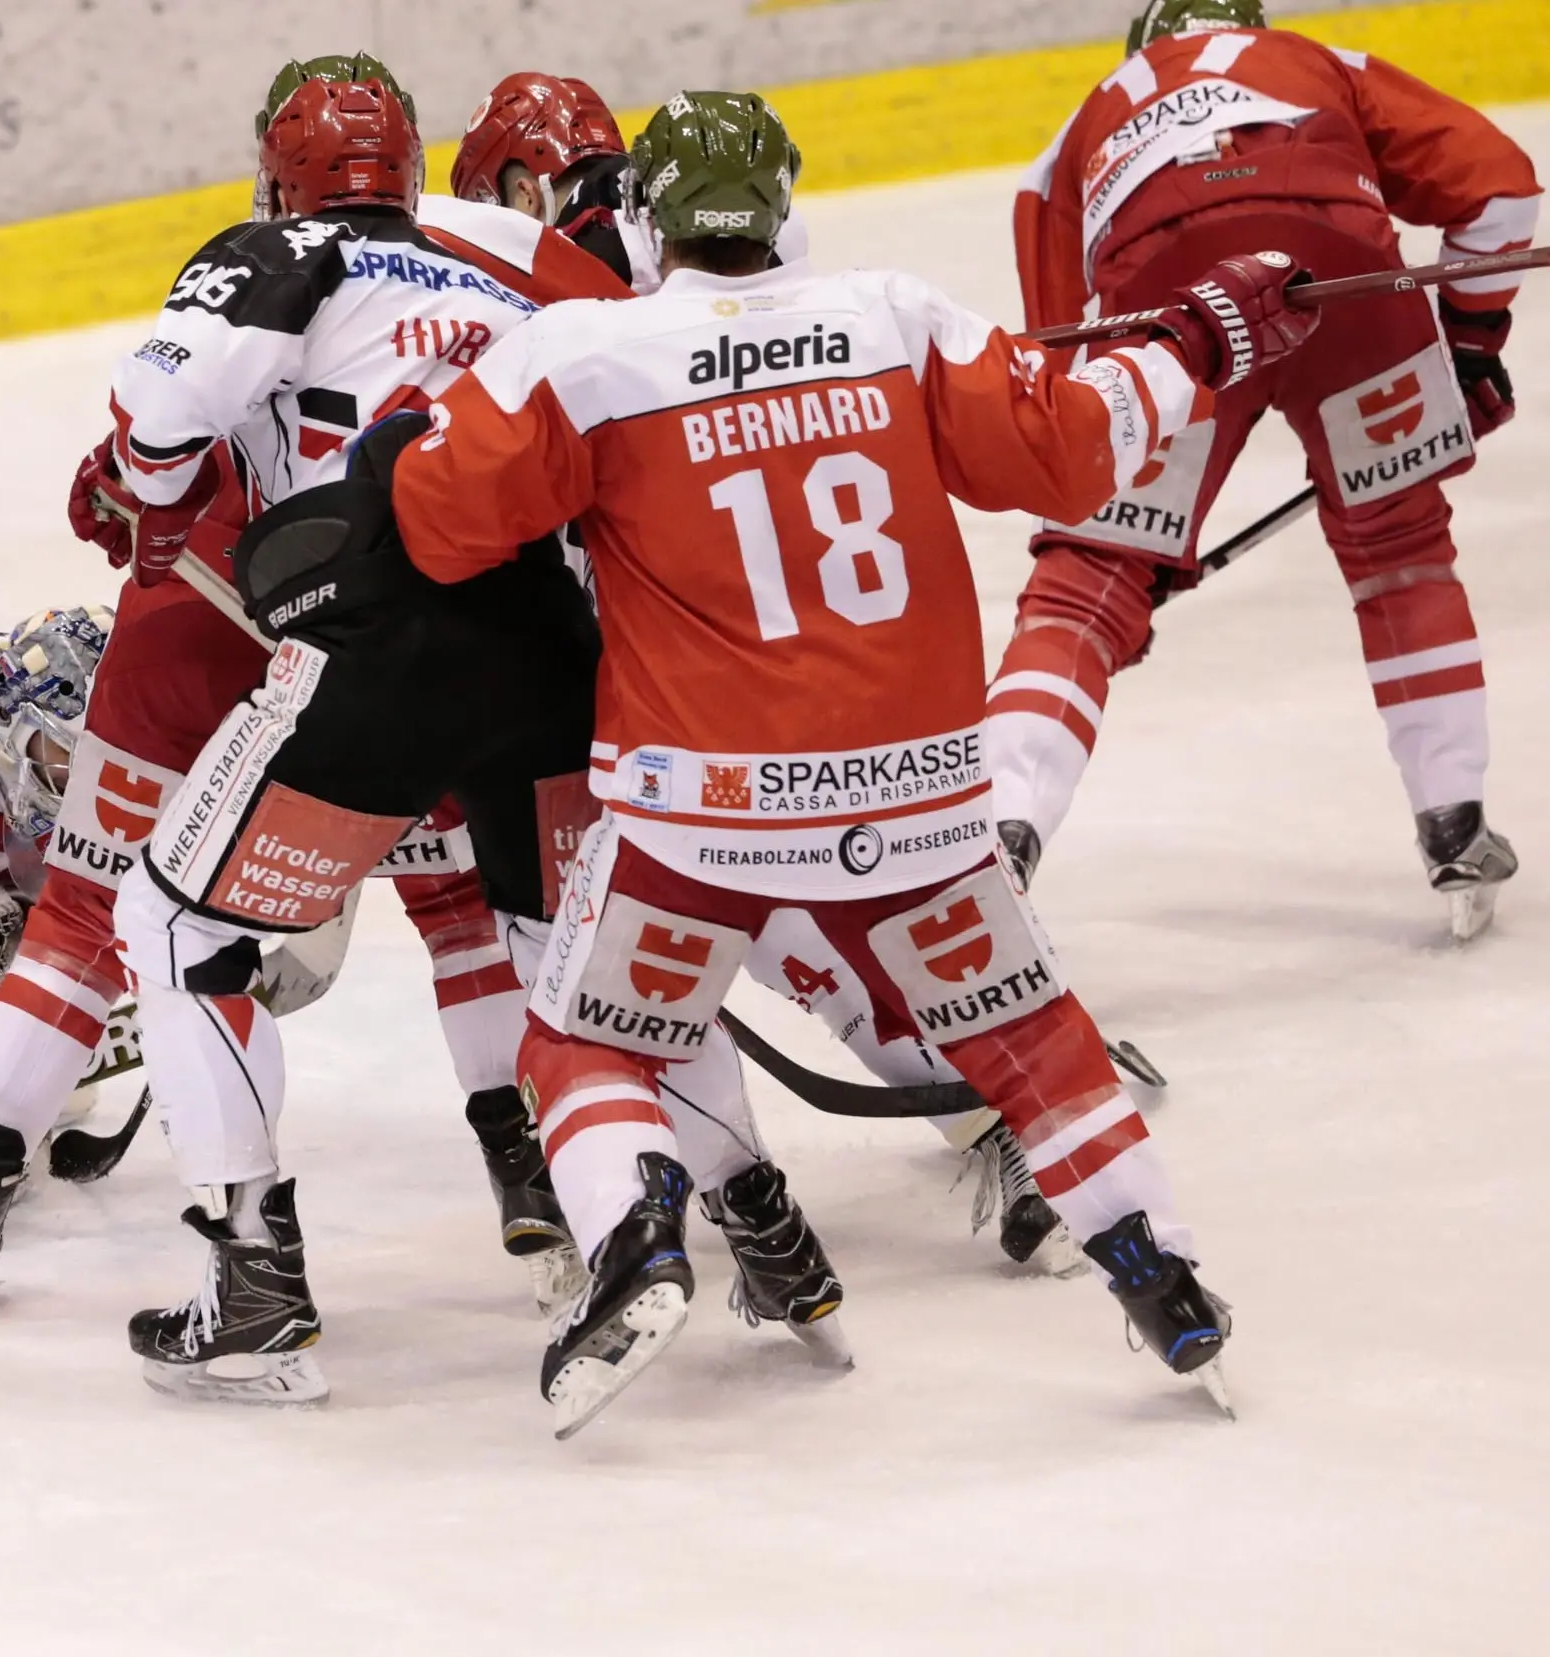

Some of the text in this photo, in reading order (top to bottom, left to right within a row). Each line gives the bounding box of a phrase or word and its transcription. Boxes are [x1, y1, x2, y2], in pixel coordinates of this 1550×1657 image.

[694, 210, 755, 228] FORST
[168, 262, 252, 308] 96
[688, 323, 851, 391] alperia
[1190, 280, 1254, 386] ARRIOR
[681, 386, 891, 464] BERNARD
[1343, 422, 1464, 493] WÜRTH
[1091, 500, 1186, 540] ÜRTH
[708, 450, 910, 641] 18
[268, 582, 337, 630] BAUER
[163, 686, 288, 877] WIENER STÄDTISHE
[759, 733, 981, 794] SPARKASSE
[227, 770, 258, 817] VIENNA
[759, 765, 982, 812] CASSA DI RISPARMIO
[253, 832, 350, 878] tiroler
[699, 818, 988, 866] FIERABOLZANO MESSEBOZEN
[226, 883, 302, 921] kraft
[241, 859, 347, 901] wasser
[915, 957, 1049, 1031] WÜRTH
[576, 991, 709, 1048] WÜRTH
